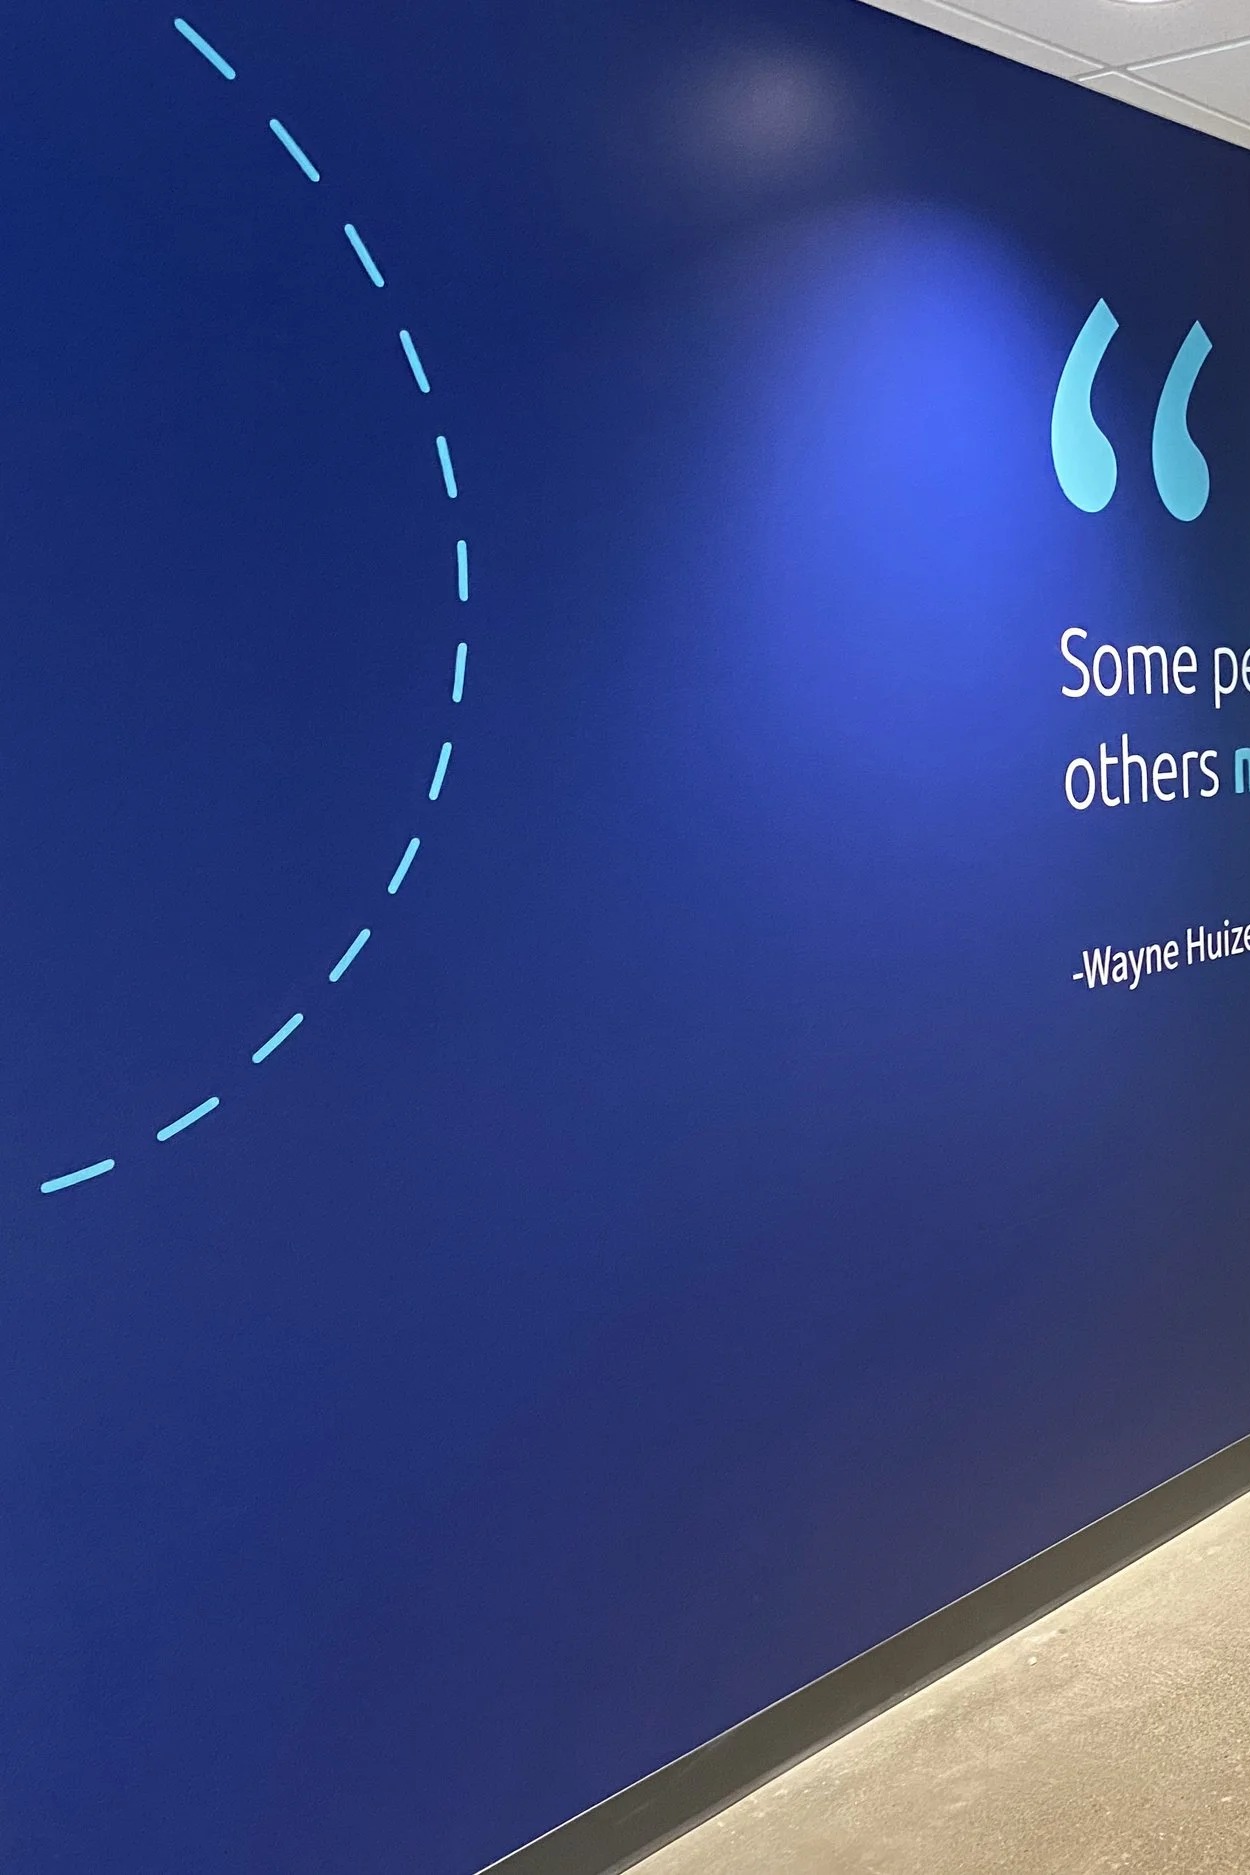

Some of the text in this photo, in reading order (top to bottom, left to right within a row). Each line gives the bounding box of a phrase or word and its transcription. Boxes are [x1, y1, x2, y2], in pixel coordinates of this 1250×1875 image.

[1060, 627, 1198, 698] Some
[1065, 733, 1220, 810] others
[1072, 940, 1179, 991] -Wayne
